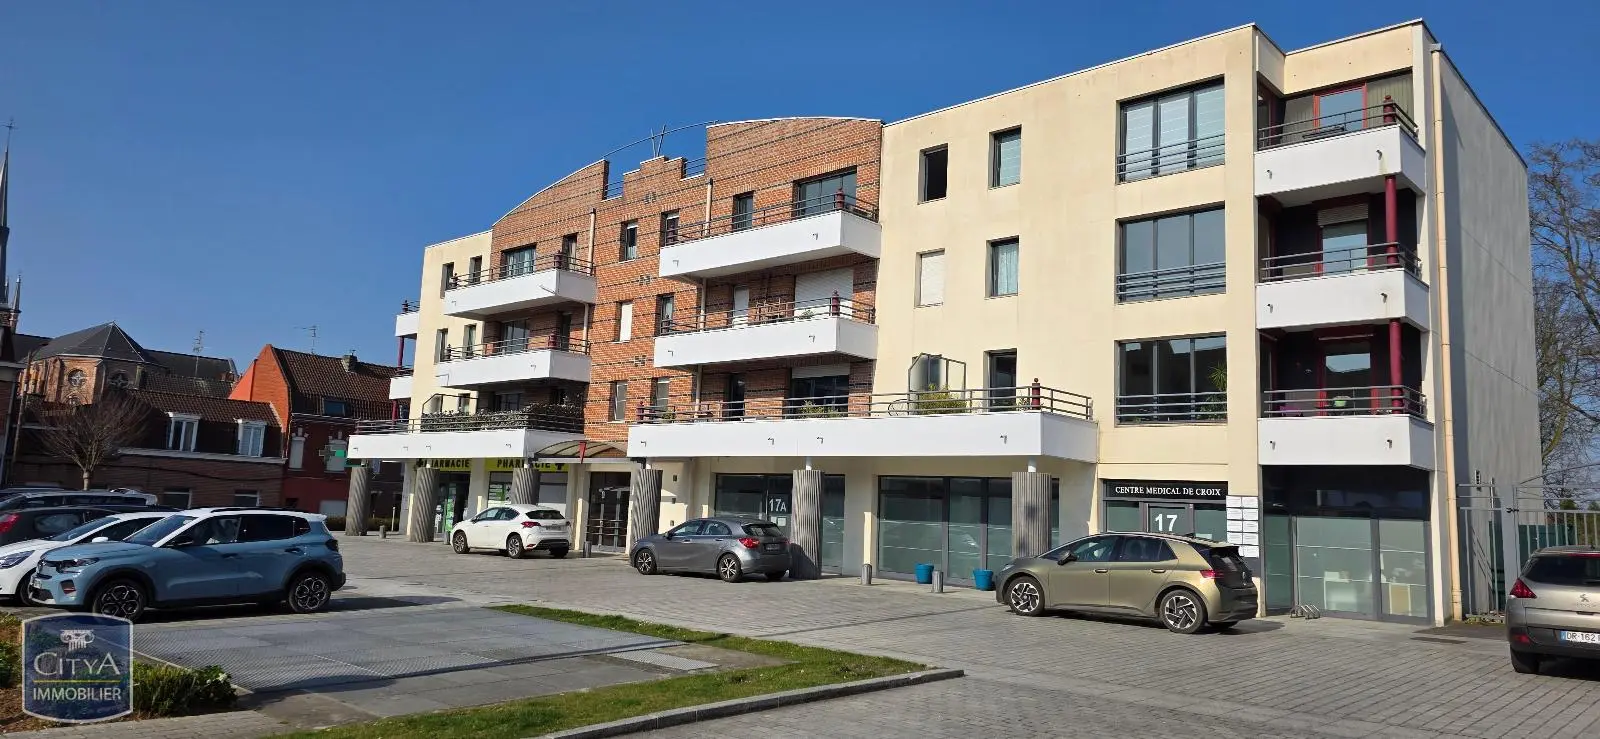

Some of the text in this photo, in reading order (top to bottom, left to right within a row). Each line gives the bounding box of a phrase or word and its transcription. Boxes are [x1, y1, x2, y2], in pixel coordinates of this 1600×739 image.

[496, 458, 551, 469] PHARCIE
[1115, 486, 1221, 496] CENTRE MEDICAL DE CROIX
[769, 498, 787, 512] 17A
[1154, 513, 1178, 532] 17
